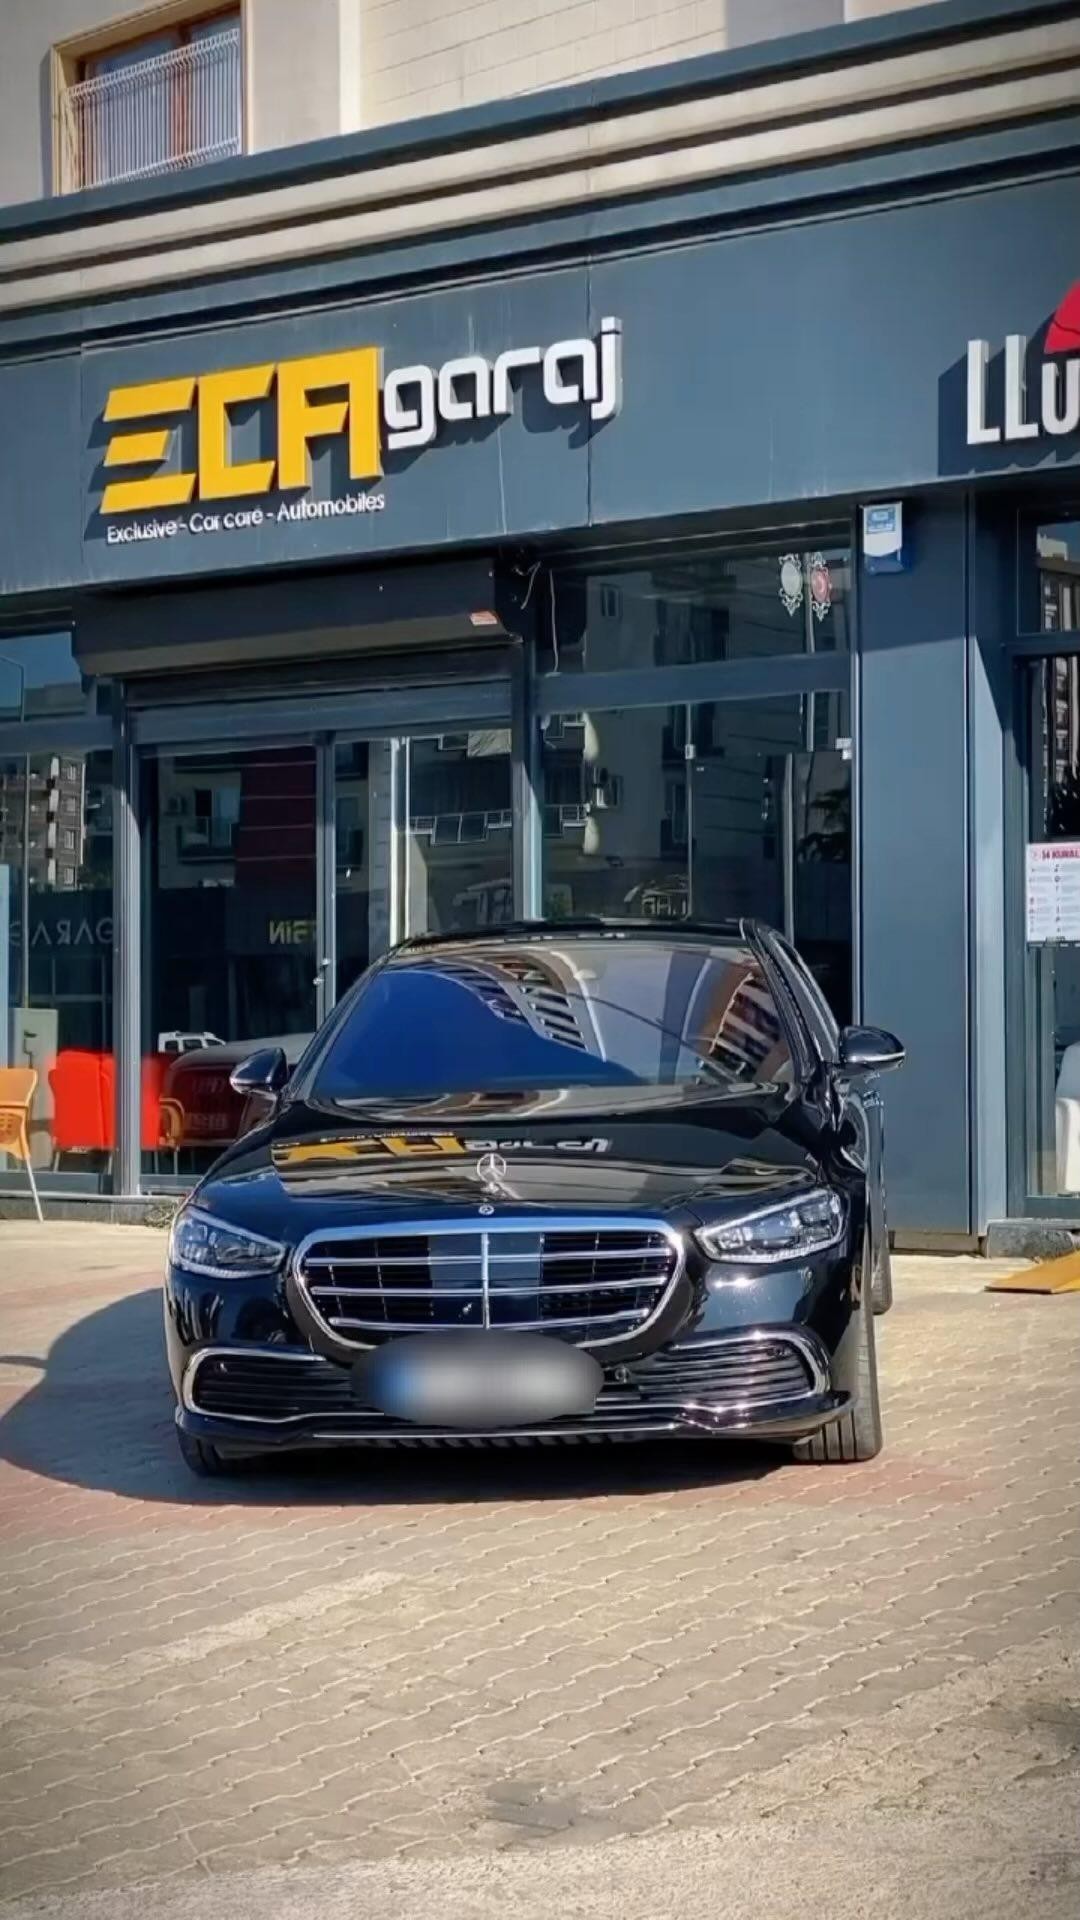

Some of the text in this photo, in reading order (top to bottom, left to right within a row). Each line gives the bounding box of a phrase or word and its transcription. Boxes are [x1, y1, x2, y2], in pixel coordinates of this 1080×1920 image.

[383, 316, 622, 451] garaj
[107, 519, 177, 544] Exclusive
[189, 513, 220, 533] Car
[223, 509, 262, 529] care
[277, 492, 385, 522] Automobiles
